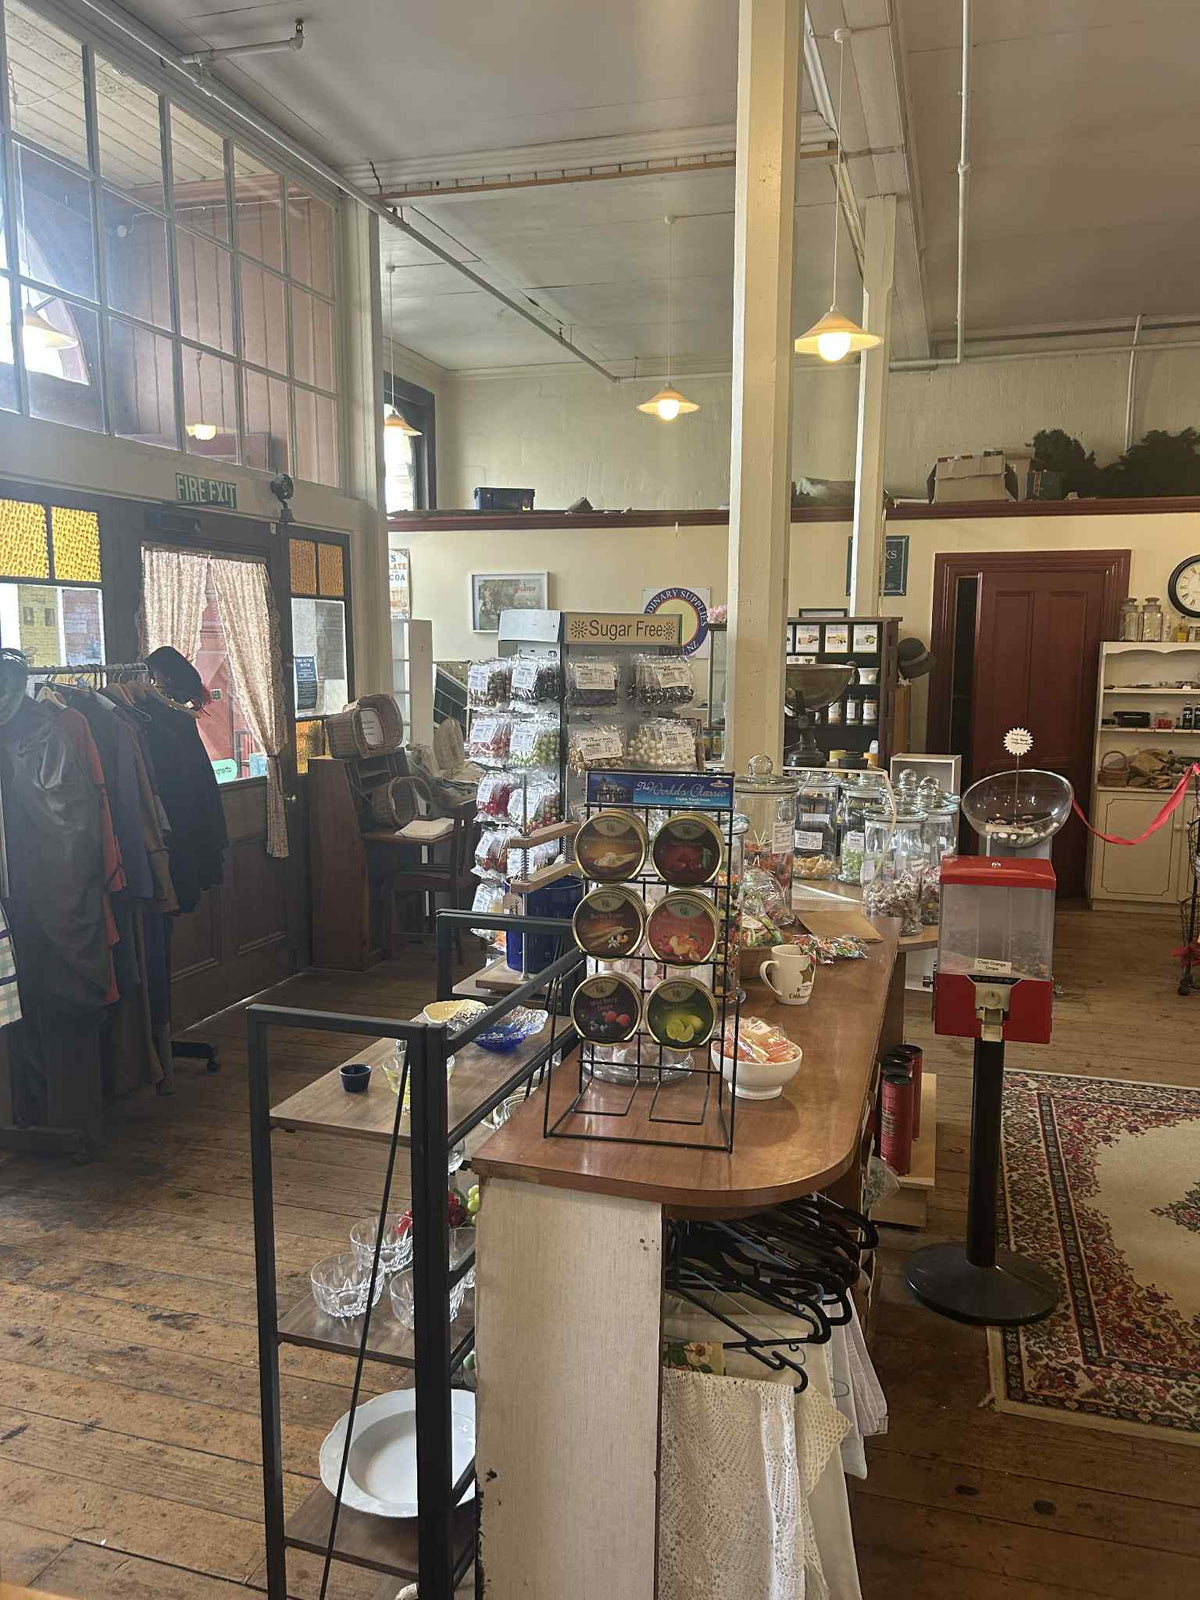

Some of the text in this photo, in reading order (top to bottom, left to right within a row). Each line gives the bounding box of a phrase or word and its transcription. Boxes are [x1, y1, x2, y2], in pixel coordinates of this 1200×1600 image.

[176, 474, 237, 508] FIRE EXIT
[680, 590, 708, 627] SUPPLIES
[588, 619, 663, 641] Sugar Free
